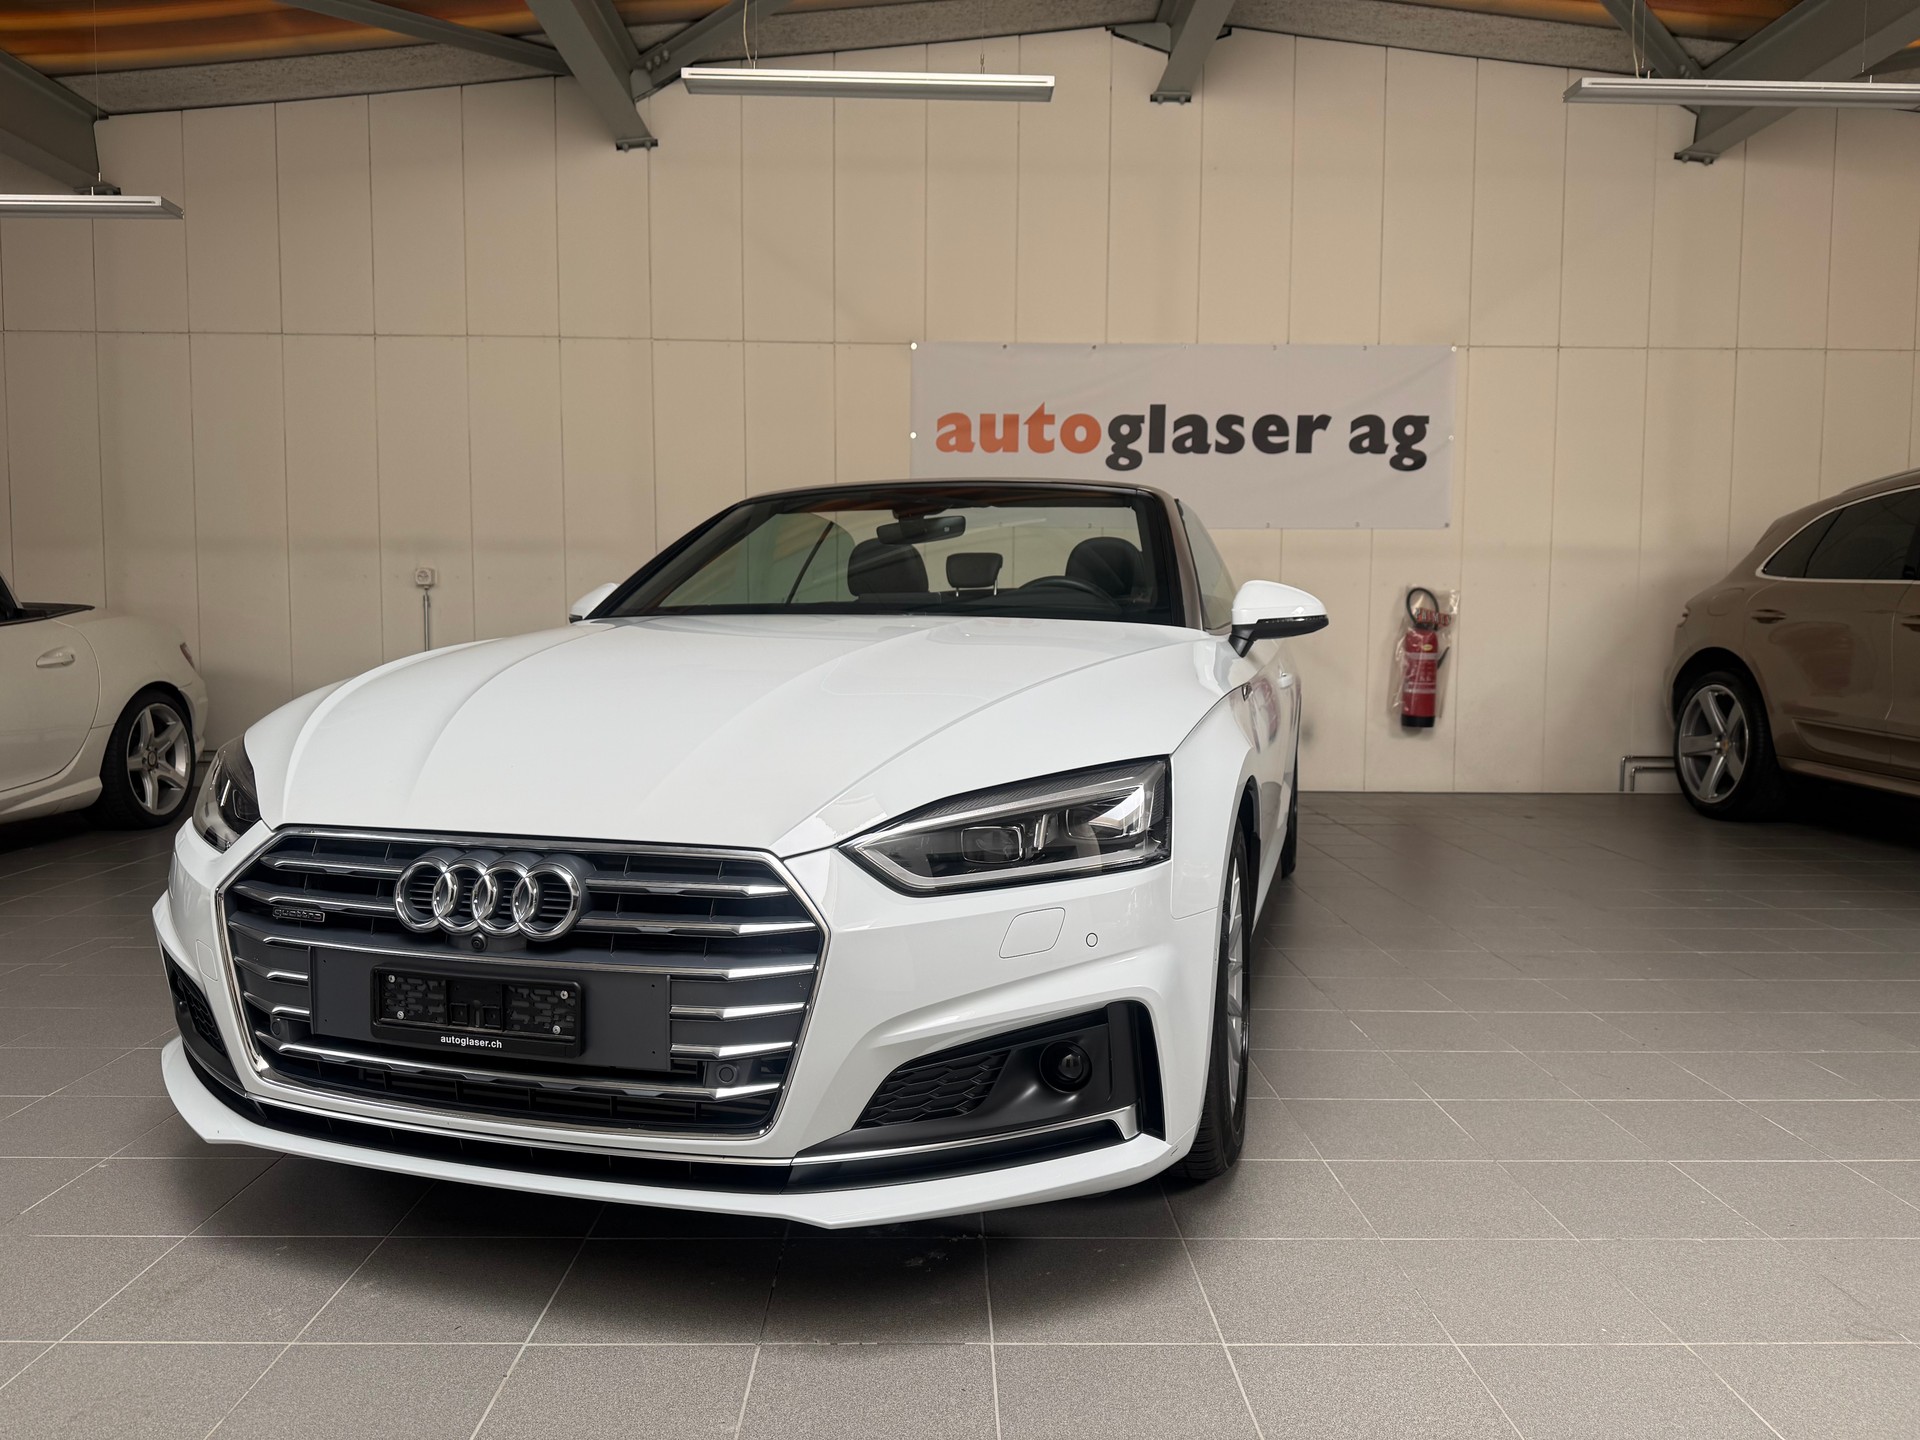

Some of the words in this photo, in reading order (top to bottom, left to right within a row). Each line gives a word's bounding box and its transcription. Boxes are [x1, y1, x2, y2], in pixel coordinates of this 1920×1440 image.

[936, 402, 1332, 471] autoglaser
[1349, 413, 1429, 471] ag
[440, 1035, 502, 1049] autoglaser.ch
